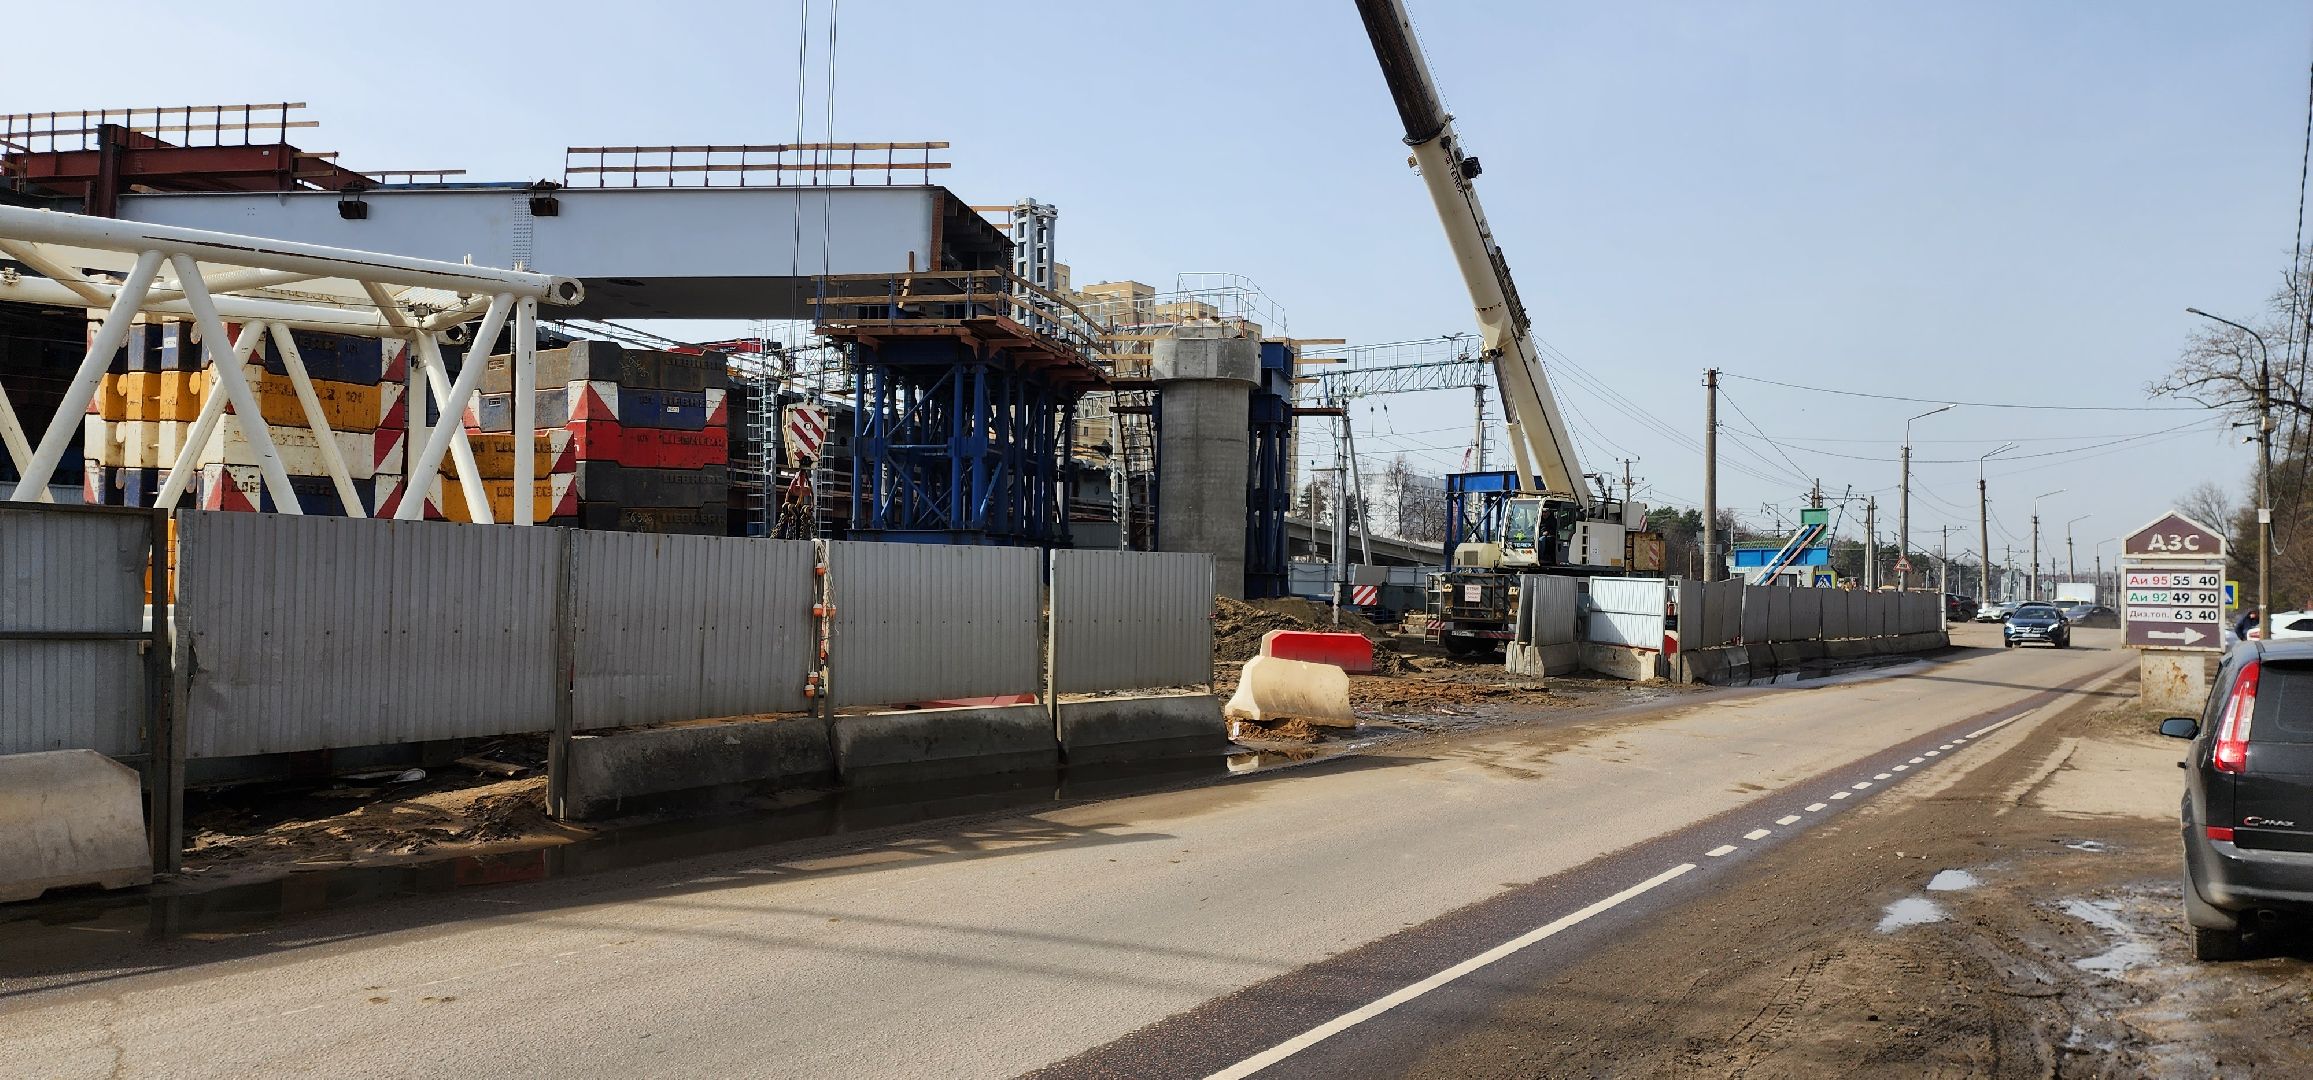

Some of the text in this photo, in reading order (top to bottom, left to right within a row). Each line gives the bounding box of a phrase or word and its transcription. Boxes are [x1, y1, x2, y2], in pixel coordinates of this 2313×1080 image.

[2148, 533, 2200, 551] АЗС
[2129, 576, 2218, 586] Аи 95 55 40
[2129, 593, 2217, 604] Аи 92 49 90
[2174, 610, 2193, 620] 63
[2198, 610, 2217, 620] 40
